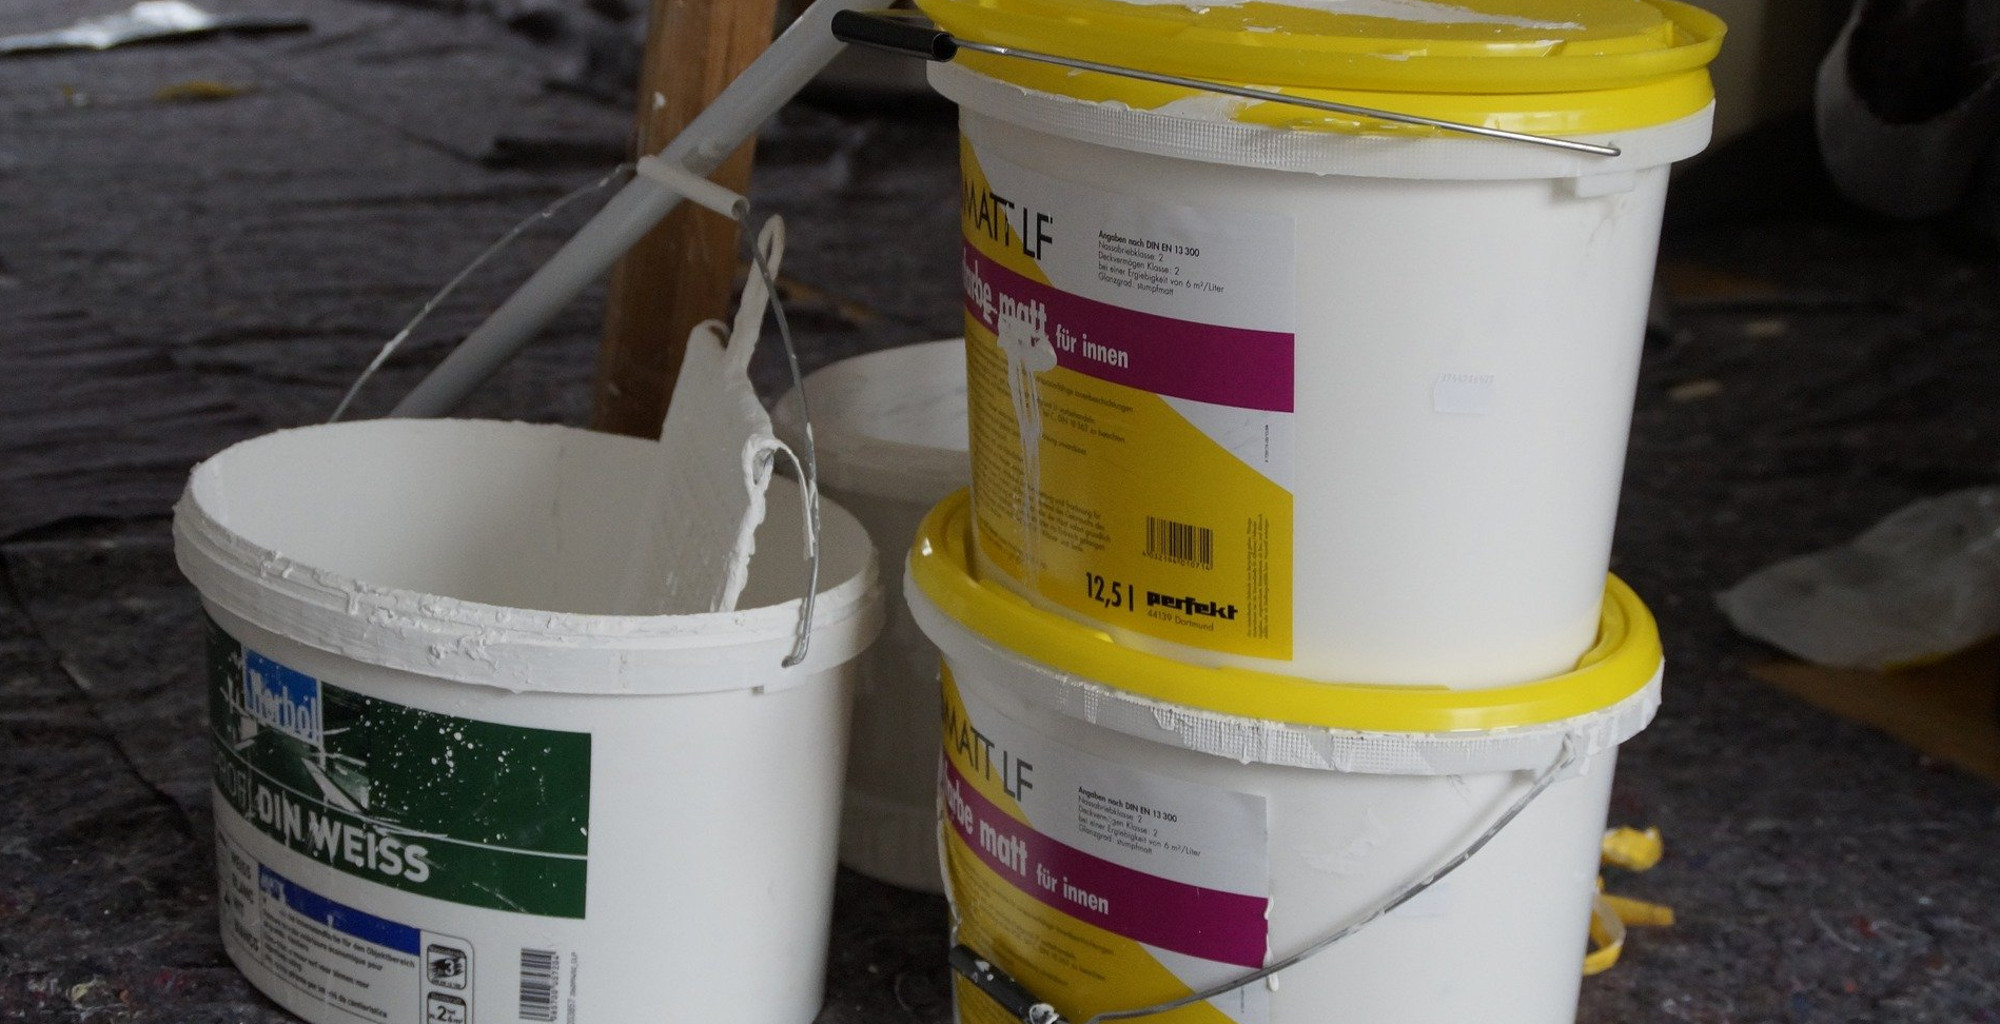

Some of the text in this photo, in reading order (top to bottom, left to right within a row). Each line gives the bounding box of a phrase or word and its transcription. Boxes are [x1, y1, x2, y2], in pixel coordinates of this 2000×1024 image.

[1023, 207, 1053, 260] LF
[1098, 230, 1200, 257] Angaben nach DIN EN 13 300
[1098, 251, 1145, 270] Deckvermögen
[1174, 267, 1180, 276] 2
[1158, 254, 1164, 262] 2
[1098, 261, 1108, 271] bei
[1110, 264, 1126, 275] einer
[1128, 268, 1169, 284] Ergiebigkeit
[1170, 279, 1183, 287] von
[1185, 279, 1191, 288] 6
[1137, 283, 1174, 296] stumpfmatt
[1056, 324, 1077, 353] für
[1082, 333, 1129, 369] innen
[1085, 571, 1122, 608] 12,5
[1147, 590, 1238, 621] perfekt
[1147, 609, 1214, 631] 44139 Dortmund
[1003, 750, 1033, 802] LF
[1078, 786, 1178, 823] Angaben nach DIN EN 13 300
[1137, 814, 1142, 824] 2
[258, 784, 302, 842] DIN
[308, 811, 430, 883] WEISS
[1089, 818, 1105, 830] einer
[1107, 823, 1147, 843] Ergiebigkeit
[1149, 839, 1162, 848] von
[1164, 840, 1169, 850] 6
[1153, 828, 1158, 838] 2
[1116, 839, 1153, 855] stumpfmatt
[979, 818, 1028, 877] matt
[1036, 863, 1058, 893] für
[1063, 877, 1109, 915] innen
[444, 959, 455, 976] 3
[437, 1005, 447, 1022] 2
